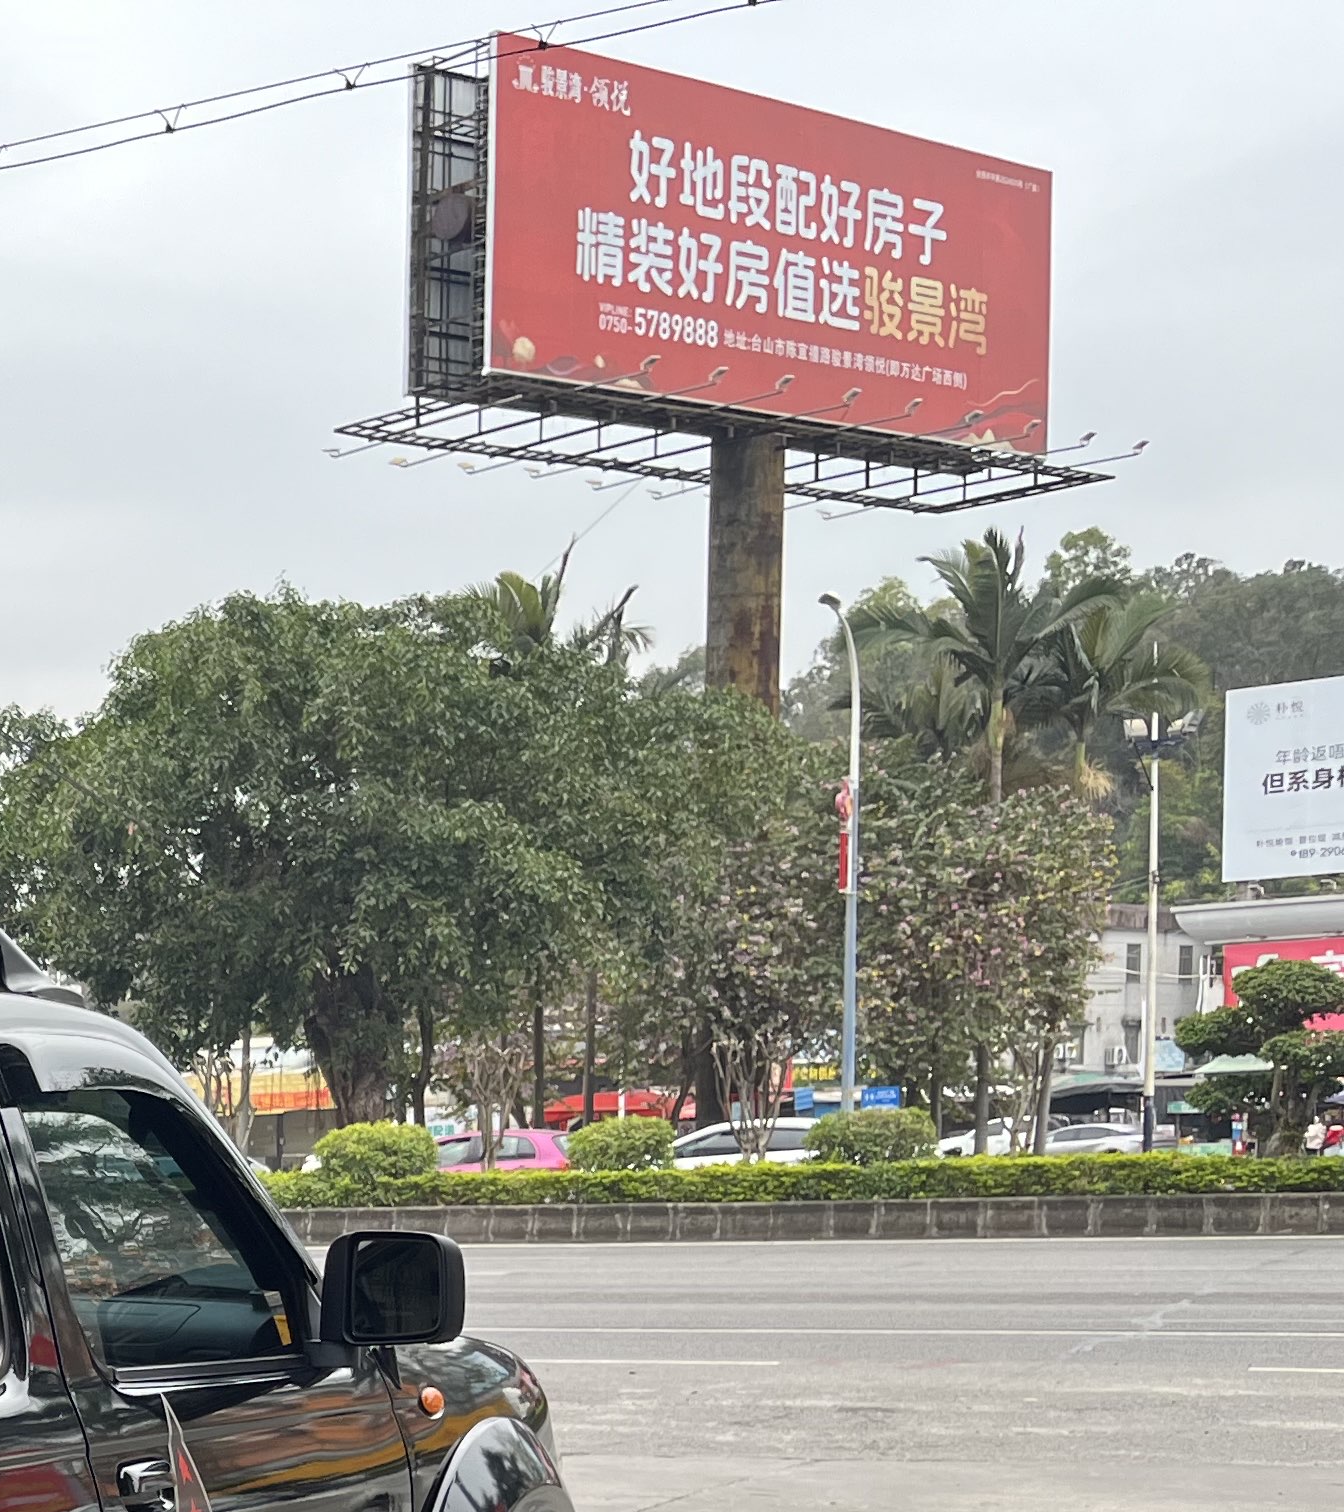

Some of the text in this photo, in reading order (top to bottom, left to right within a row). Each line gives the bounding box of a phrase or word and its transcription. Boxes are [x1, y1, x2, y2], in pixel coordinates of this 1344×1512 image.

[628, 130, 948, 266] 好地段配好房子
[575, 207, 989, 357] 精装好房值选骏景湾
